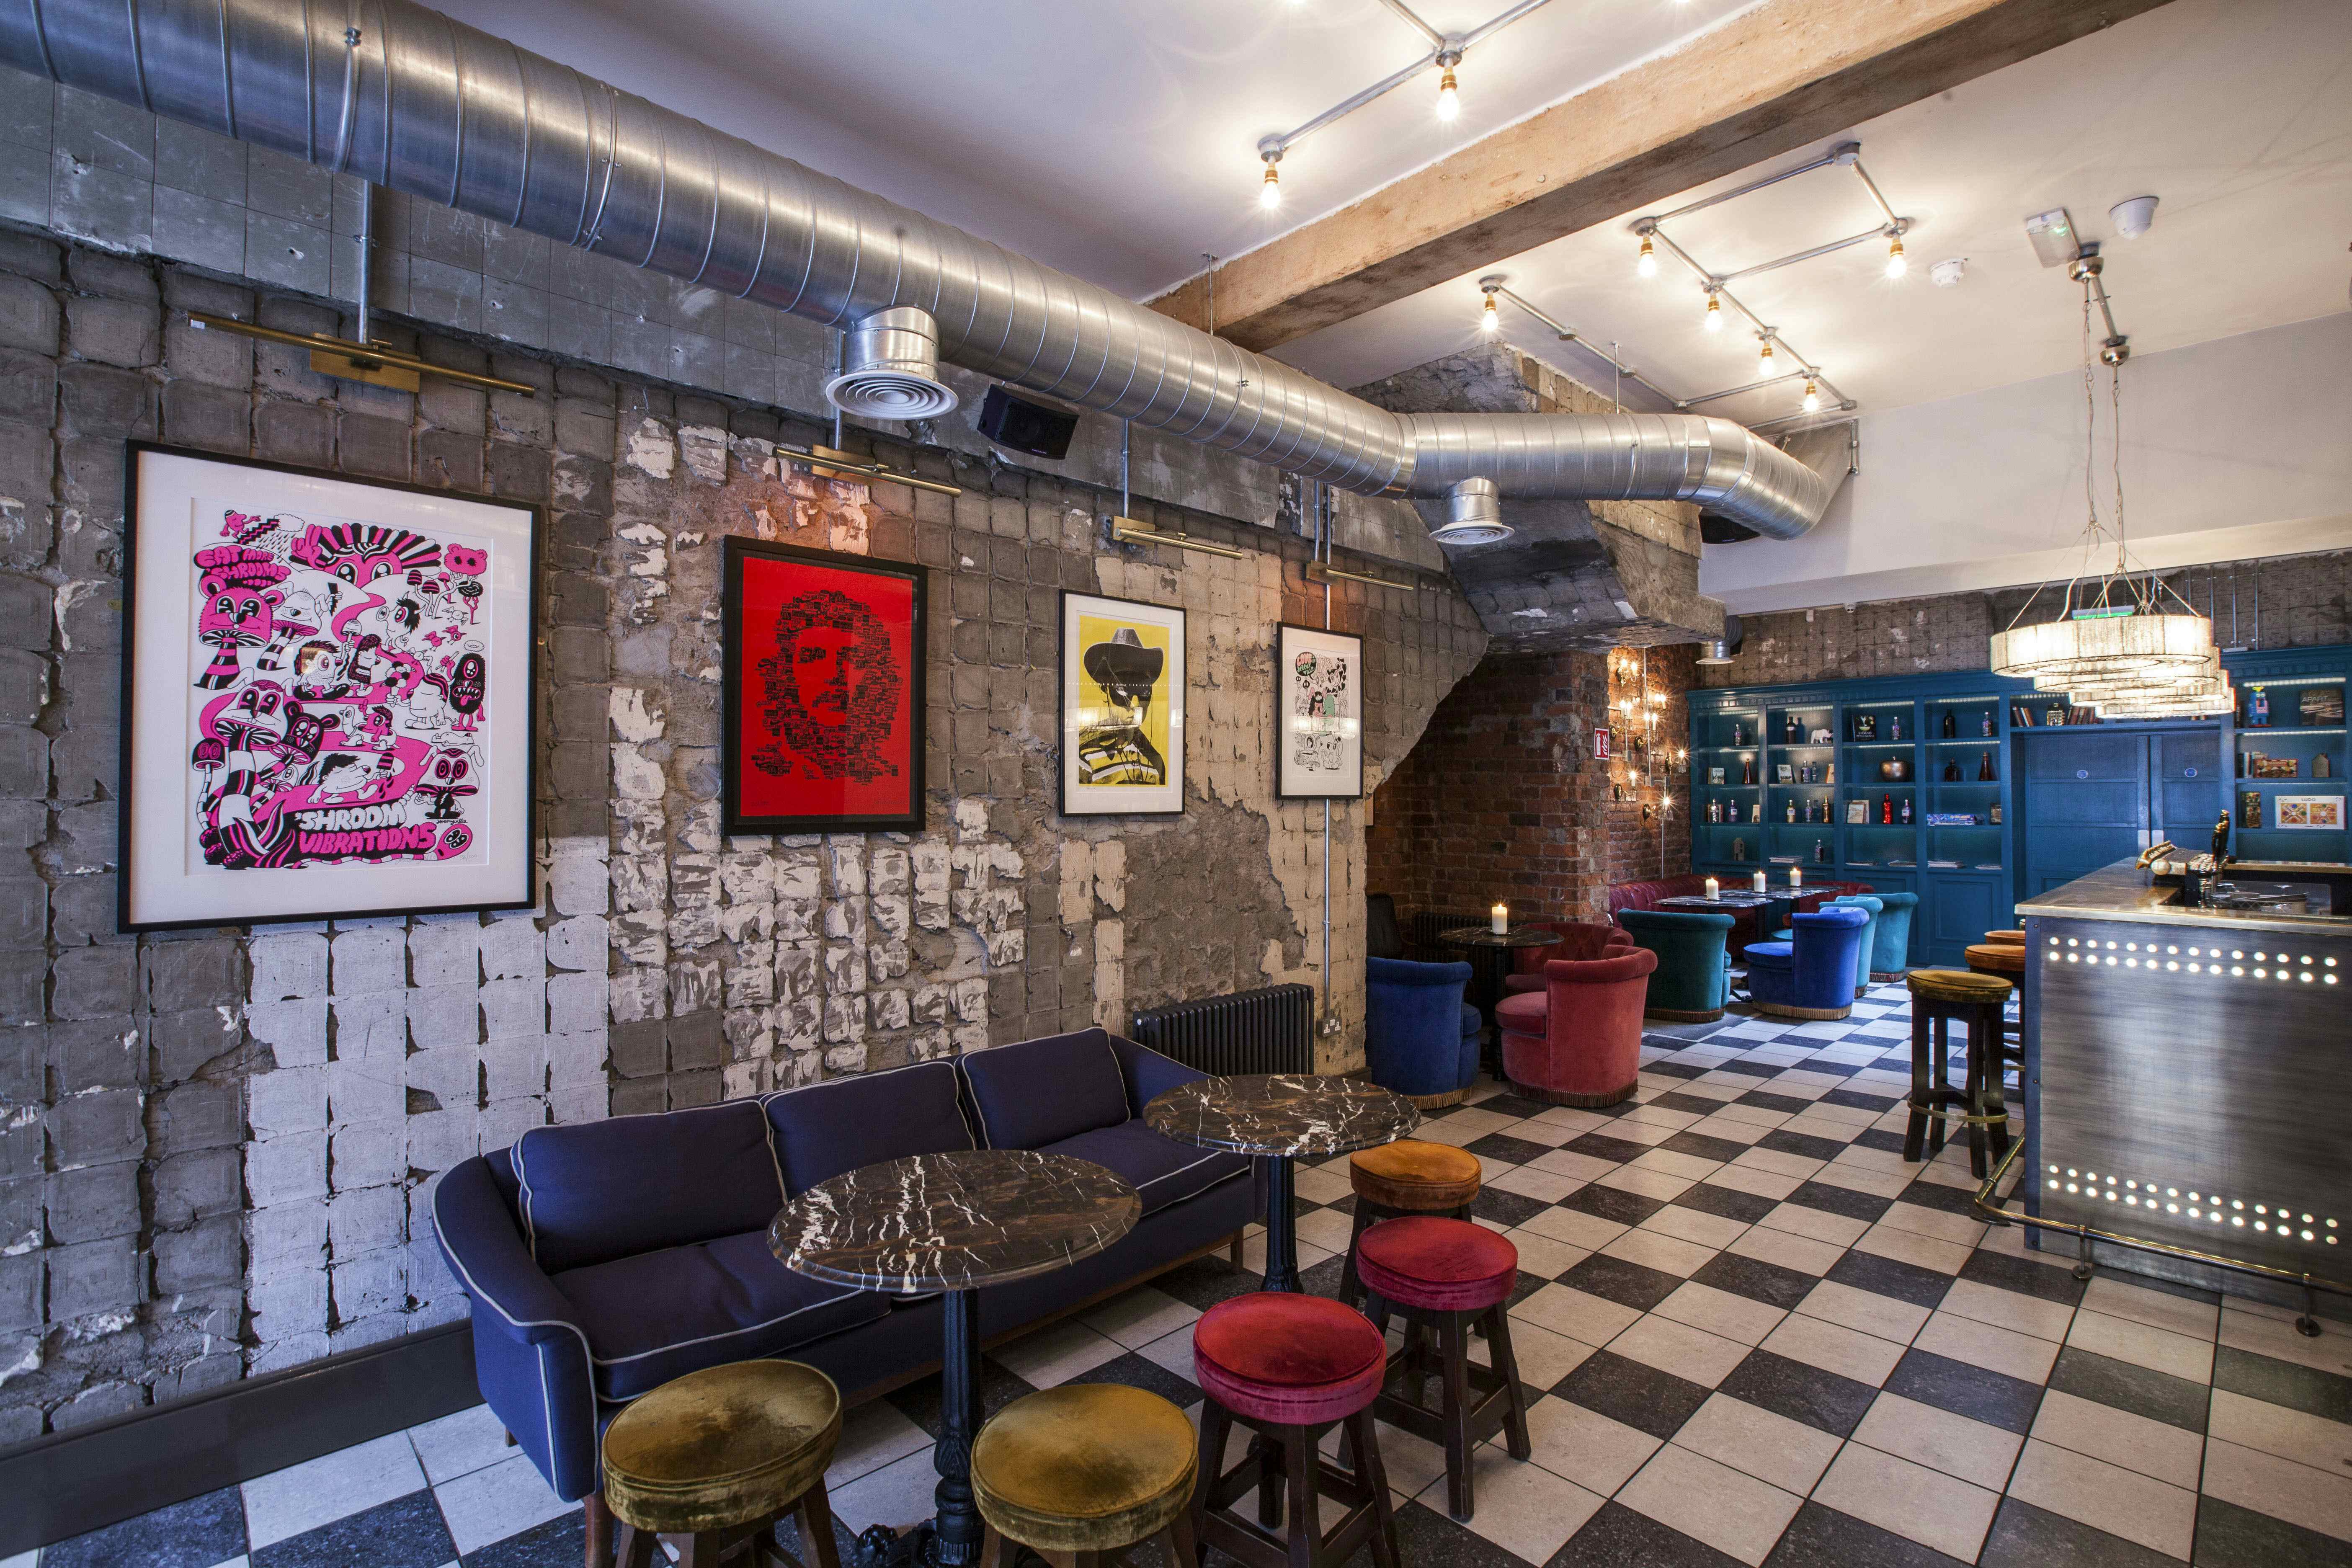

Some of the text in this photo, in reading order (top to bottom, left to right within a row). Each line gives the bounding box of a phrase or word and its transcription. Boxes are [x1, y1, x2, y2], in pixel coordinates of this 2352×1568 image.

[195, 545, 274, 567] EAT MORE
[299, 822, 437, 854] VIBRATIONS
